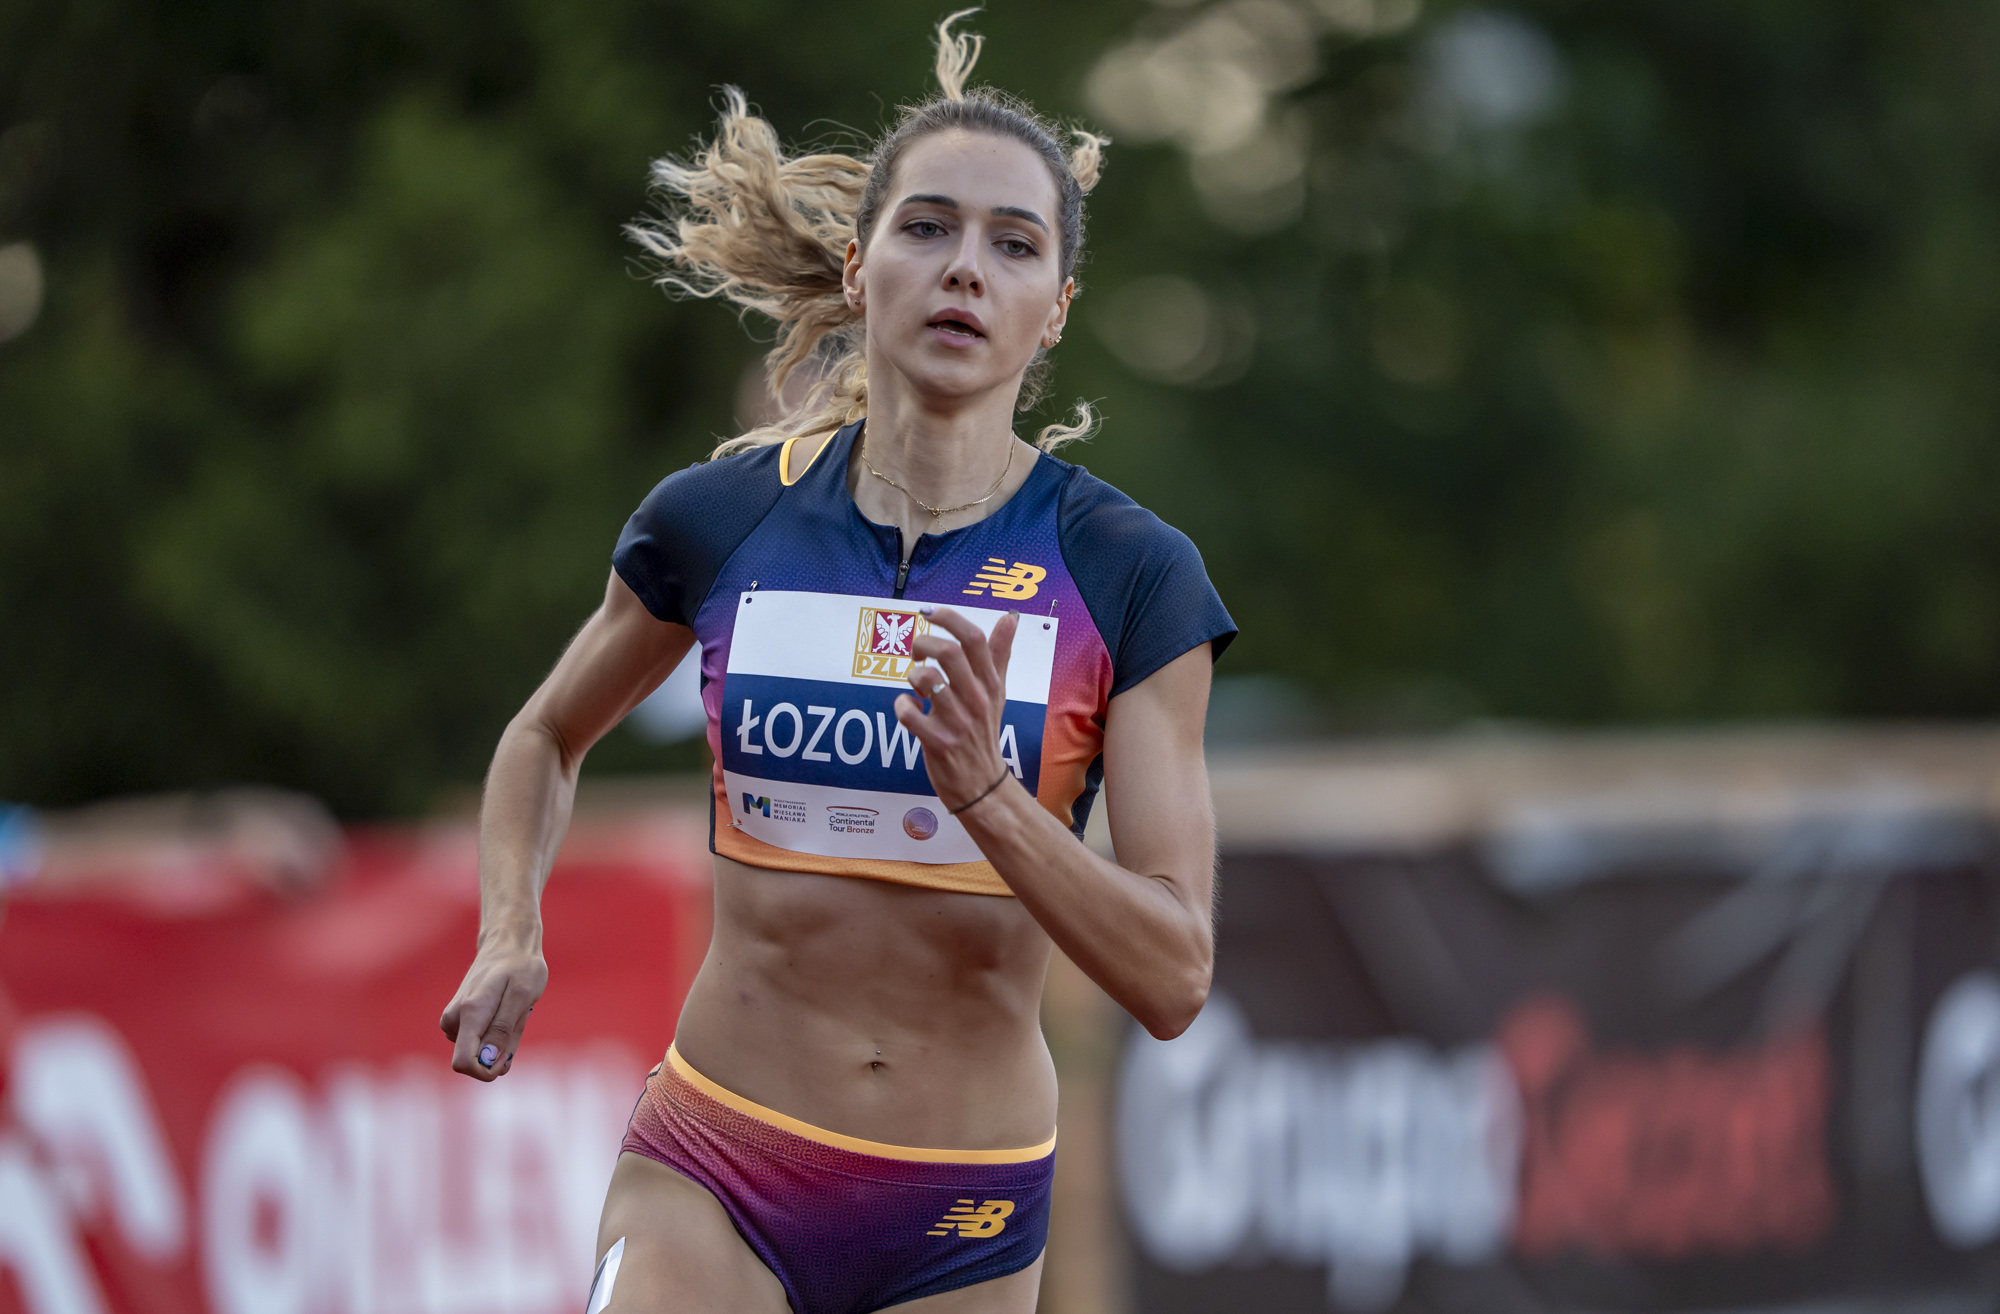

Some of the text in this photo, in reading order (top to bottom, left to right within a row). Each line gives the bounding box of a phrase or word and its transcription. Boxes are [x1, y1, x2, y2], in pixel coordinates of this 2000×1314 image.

[737, 699, 1024, 780] ŁOZOWA
[774, 814, 807, 823] MANIAKA
[829, 815, 875, 827] Continental
[829, 823, 875, 834] Tour Bronze
